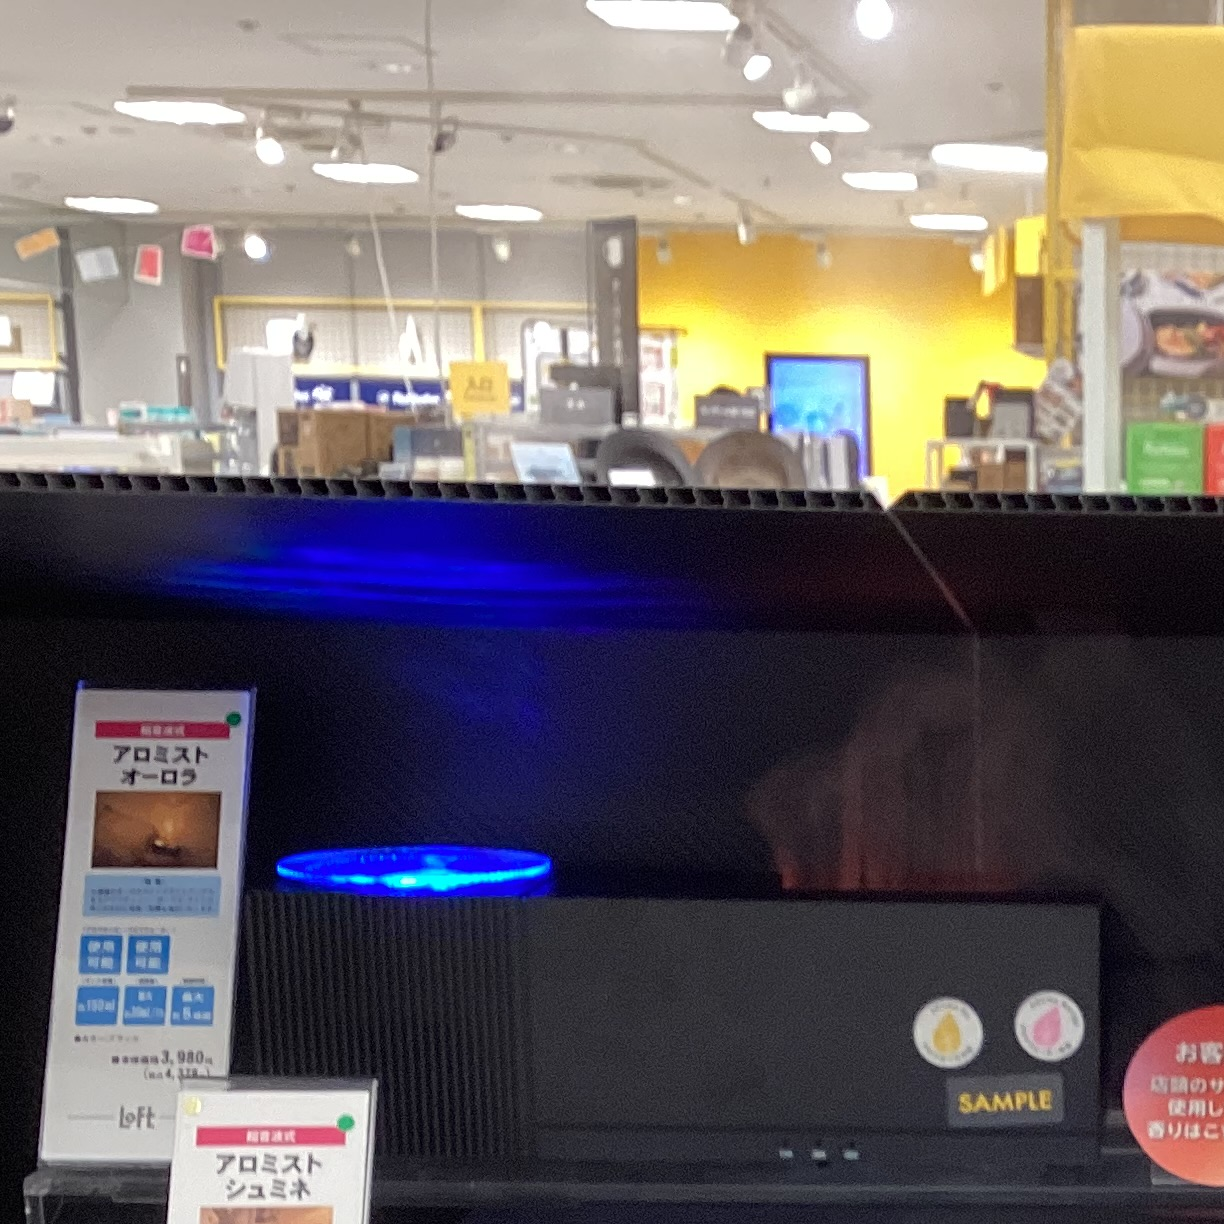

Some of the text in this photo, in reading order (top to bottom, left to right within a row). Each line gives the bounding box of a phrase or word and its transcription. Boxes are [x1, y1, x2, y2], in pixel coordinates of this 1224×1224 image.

[113, 746, 208, 764] アロミスト
[121, 769, 197, 785] オーロラ
[958, 1088, 1052, 1114] SAMPLE
[216, 1154, 322, 1175] アロミスト
[226, 1179, 311, 1201] シュミネ
